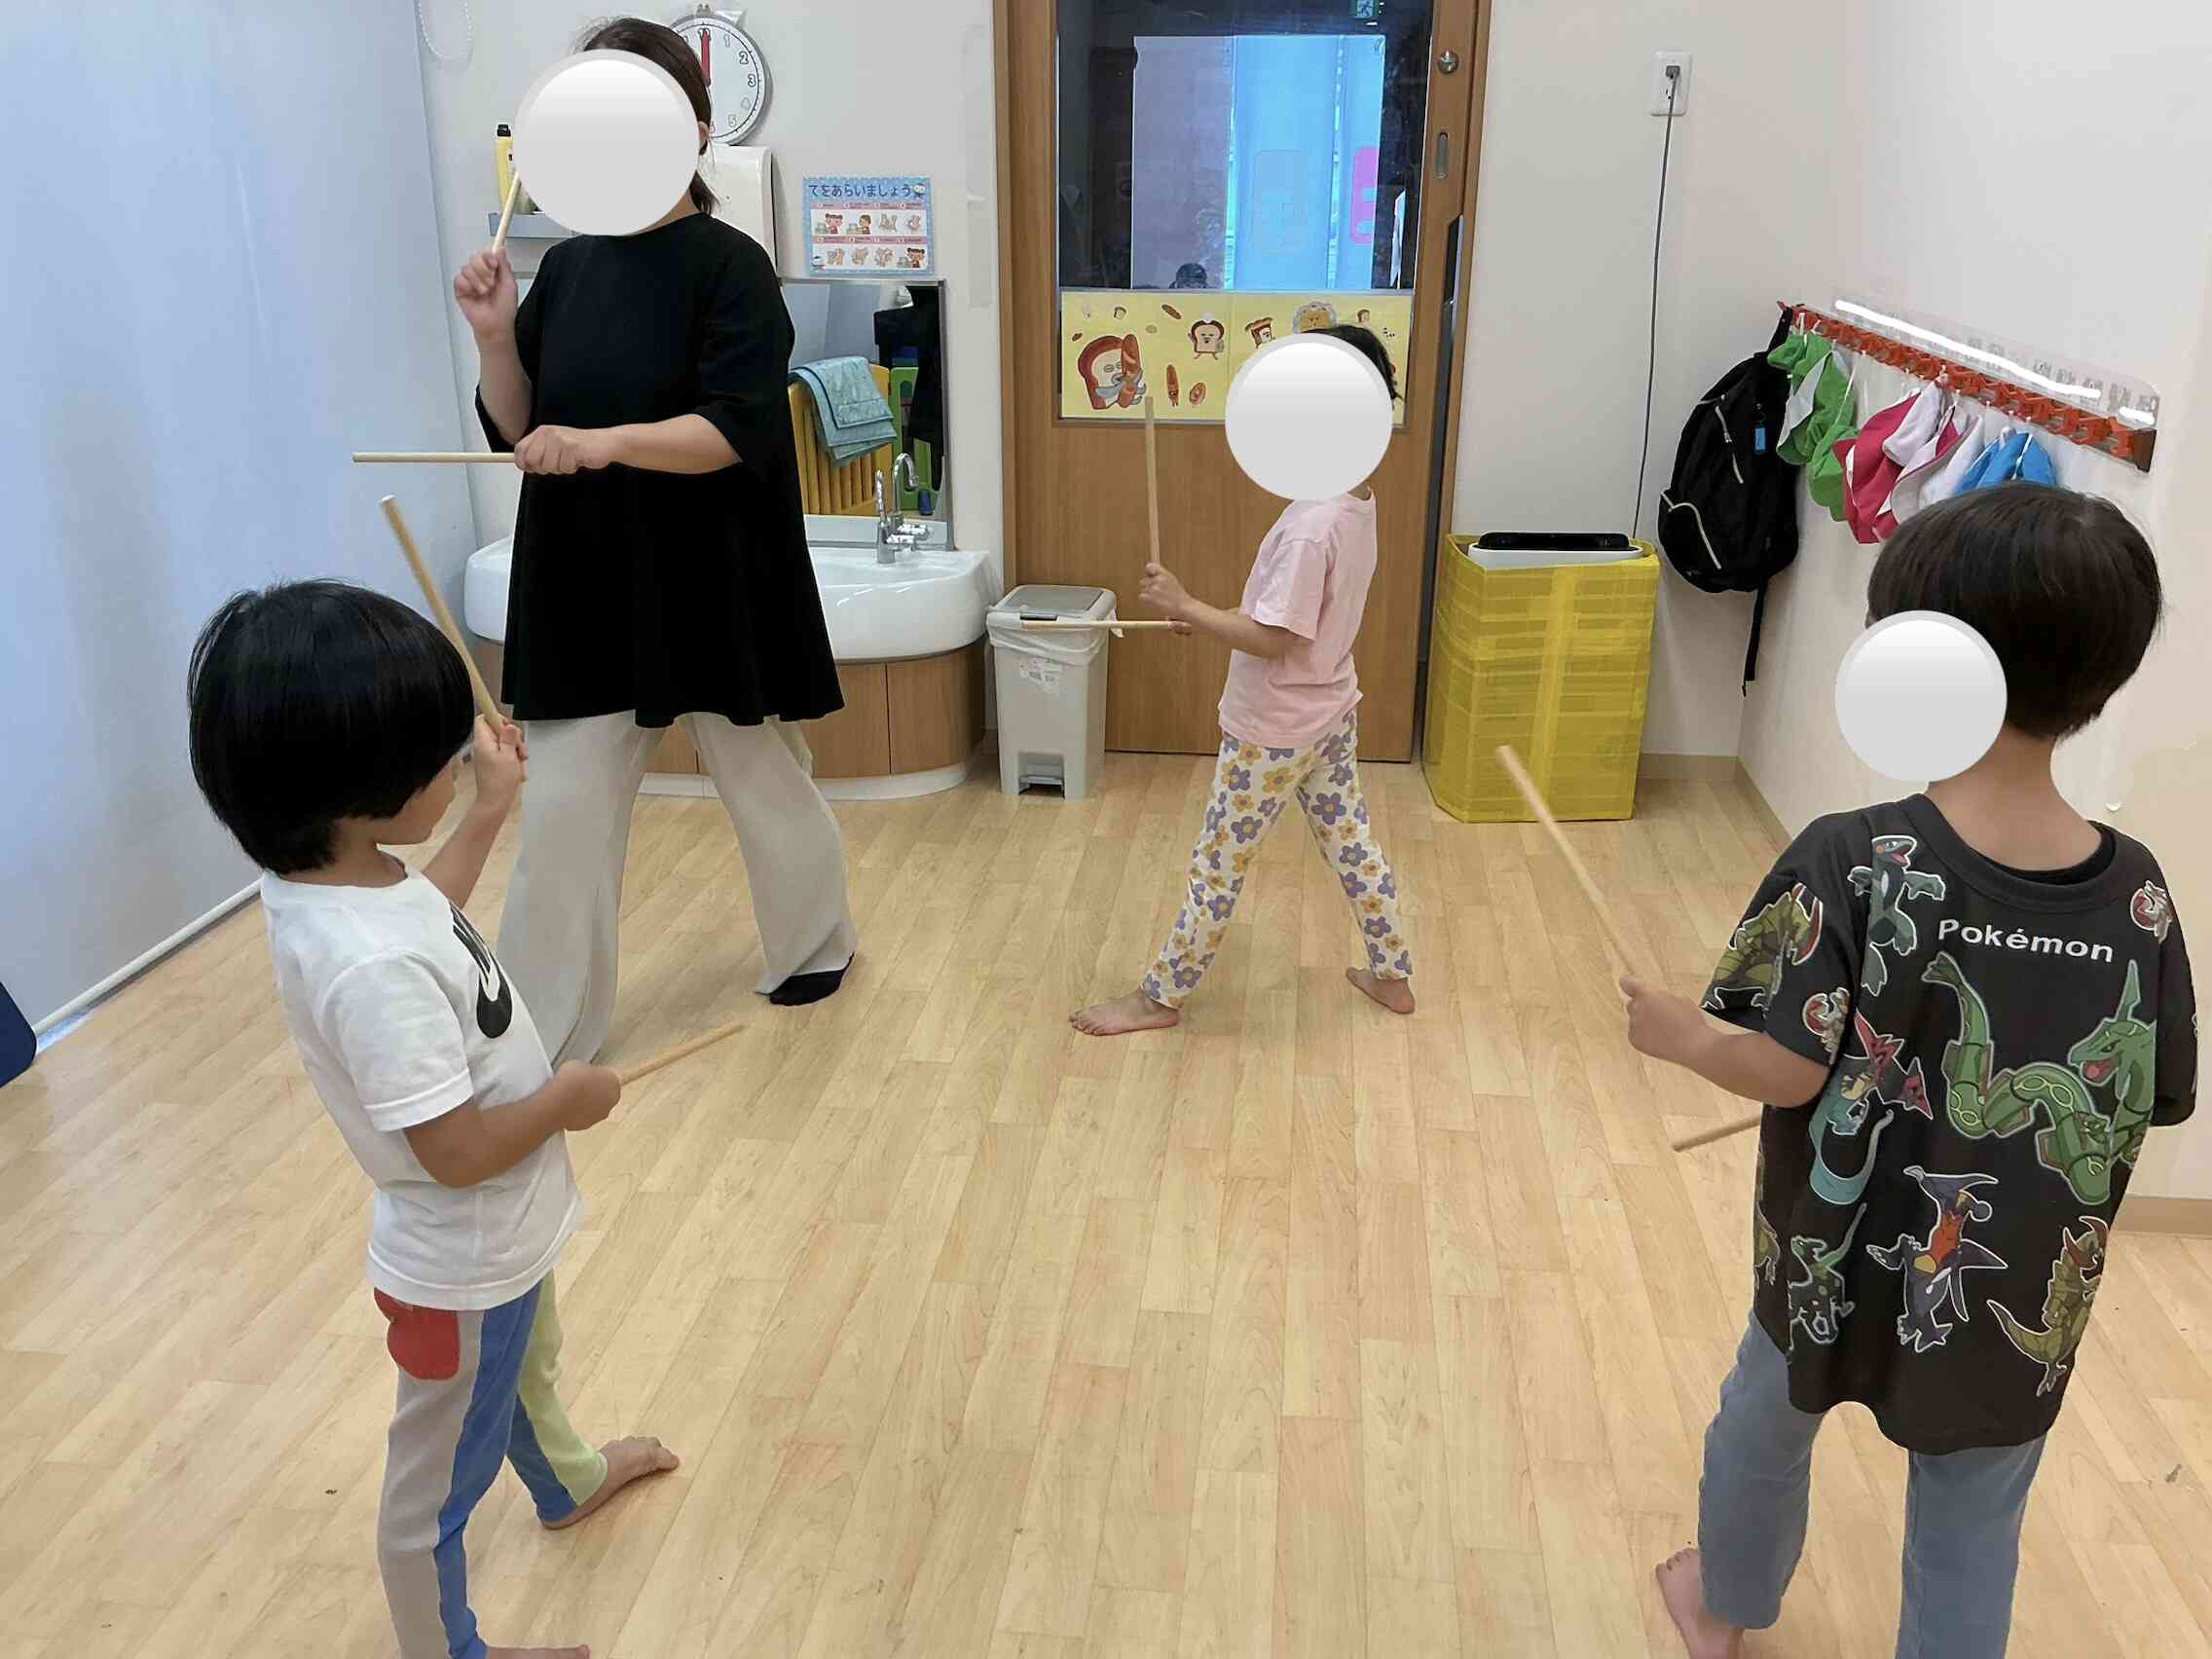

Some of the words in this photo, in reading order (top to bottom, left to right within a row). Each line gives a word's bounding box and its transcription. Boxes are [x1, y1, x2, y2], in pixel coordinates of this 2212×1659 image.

[723, 34, 730, 48] 1
[739, 51, 749, 65] 2
[748, 74, 756, 88] 3
[727, 114, 737, 128] 5
[808, 184, 911, 197] てをあらいましょう
[1937, 918, 2114, 963] Pokémon
